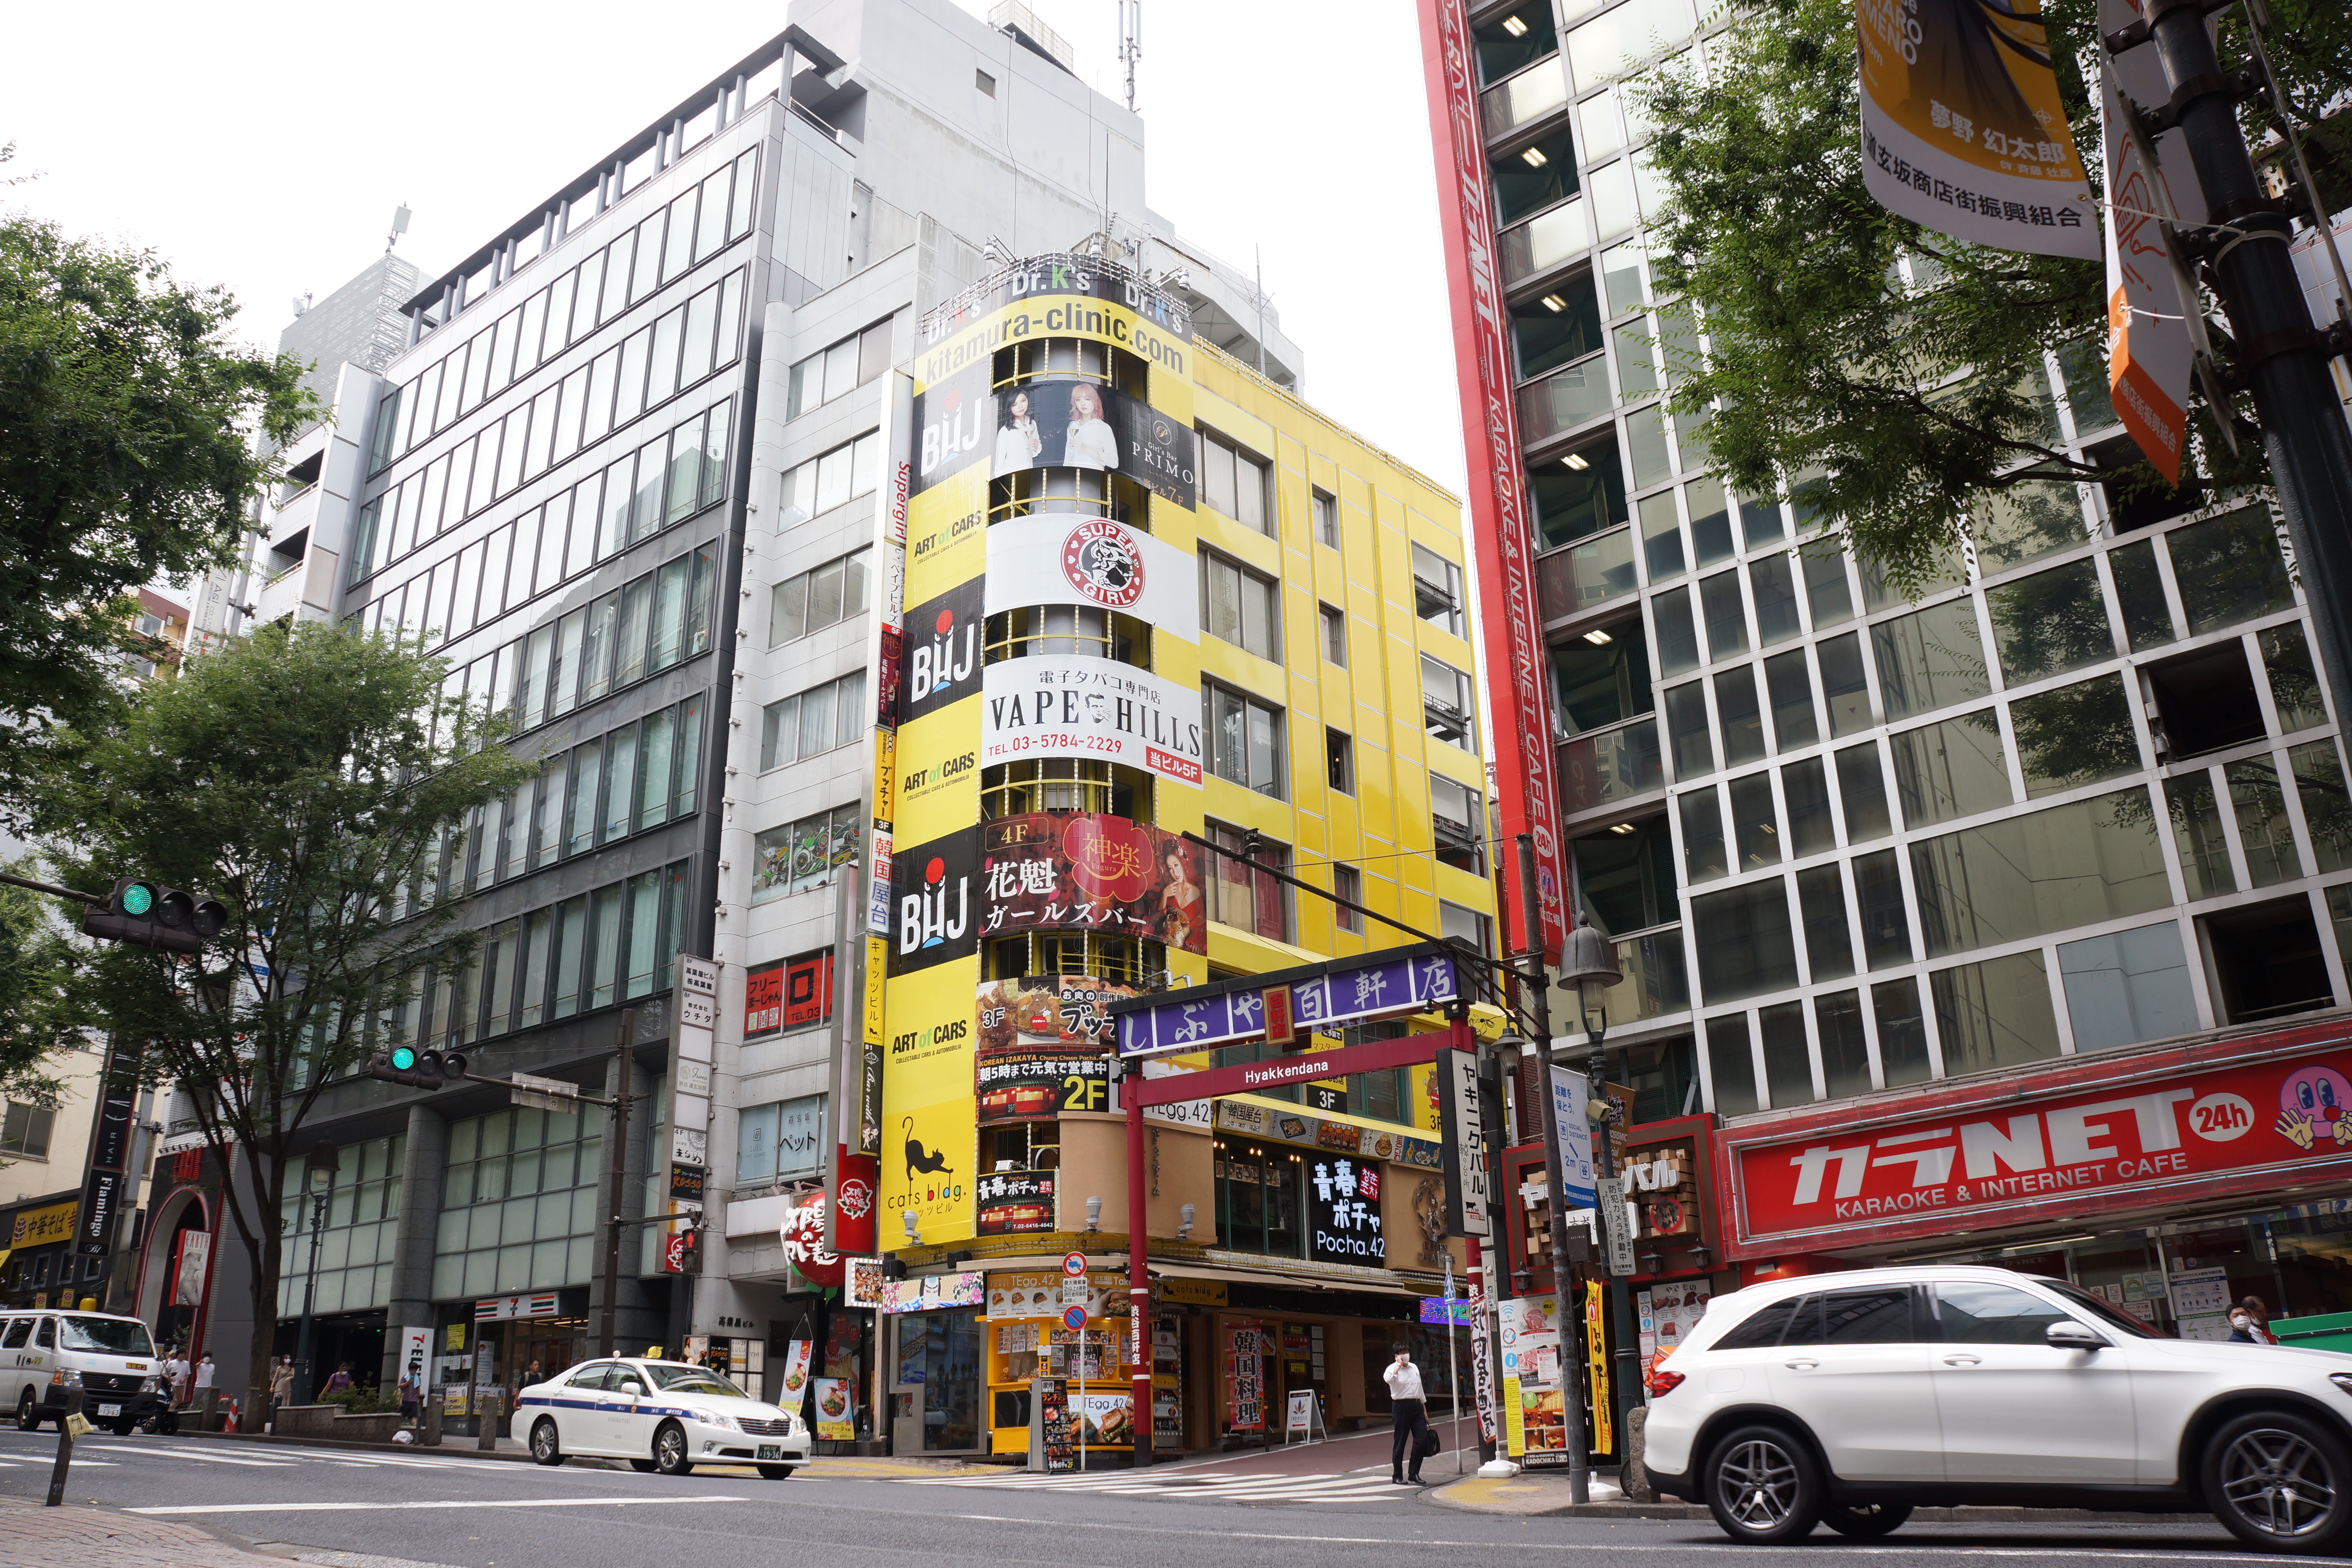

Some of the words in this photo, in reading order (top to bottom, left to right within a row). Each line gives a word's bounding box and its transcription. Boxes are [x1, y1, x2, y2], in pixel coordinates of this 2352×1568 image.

[1931, 99, 1975, 143] 夢野
[1983, 127, 2066, 164] 幻太郎
[1012, 265, 1091, 297] Dr.K's
[1125, 282, 1183, 334] Dr.K's
[926, 303, 1184, 385] kitamura-clinic.com
[1132, 441, 1194, 485] PRIMO
[1147, 440, 1165, 458] Girl's
[1166, 451, 1178, 462] Bar
[1490, 394, 1516, 539] KARAOKE
[892, 460, 911, 540] Supergirl
[914, 533, 937, 558] ART
[938, 526, 950, 546] of
[951, 510, 982, 538] CARS
[1078, 524, 1136, 557] SUPER
[1506, 540, 1519, 559] &
[1083, 582, 1131, 605] GIRL
[891, 627, 901, 635] 5F
[1509, 567, 1536, 723] INTERNET
[879, 659, 888, 710] 花魁ガールズバー
[1039, 670, 1161, 705] 電子タバコ専門店
[990, 690, 1079, 731] VAPE
[1114, 696, 1201, 757] HILLS
[988, 734, 1122, 757] TEL.03-5784-2229
[904, 769, 928, 794] ART
[928, 764, 941, 784] of
[943, 751, 975, 778] CARS
[1150, 751, 1198, 779] 当ビル5F
[1527, 737, 1546, 821] CAFE
[879, 765, 893, 817] ブッチャー
[907, 788, 931, 802] COLLECTABLE
[931, 783, 941, 792] CARS
[945, 774, 969, 787] AUTOMOBILIA
[878, 820, 890, 830] 3F
[1001, 824, 1029, 844] 4F
[1082, 833, 1141, 878] 神楽
[1535, 831, 1552, 852] 24h
[984, 857, 1058, 901] 花魁
[1091, 862, 1117, 873] kagura
[870, 837, 893, 927] 韓国屋台
[983, 901, 1147, 933] ガールズバー
[686, 967, 715, 980] 高葉屋ビル
[749, 978, 779, 995] フリー
[868, 941, 880, 1022] キャッツビル
[688, 1002, 708, 1012] 株式会社
[748, 990, 782, 1009] まーじゃん
[1061, 989, 1096, 1002] お肉の
[684, 1009, 712, 1023] ウチダ
[982, 1007, 1005, 1029] 3F
[1269, 993, 1286, 1039] 百軒店
[892, 1032, 918, 1054] ART
[918, 1028, 932, 1049] of
[933, 1019, 967, 1045] CARS
[896, 1053, 921, 1065] COLLECTABLE
[921, 1051, 931, 1059] CARS
[936, 1043, 962, 1055] AUTOMOBILIA
[980, 1058, 1004, 1067] KOREAN
[1006, 1054, 1037, 1063] IZAKAYA
[980, 1061, 1107, 1082] 朝5時まで元気で営業中
[1245, 1061, 1328, 1085] Hyakkendana
[1063, 1075, 1106, 1110] 2F
[1319, 1091, 1336, 1109] 3F
[1555, 1084, 1572, 1099] 距離を
[788, 1112, 811, 1125] 道玄坂
[1228, 1102, 1261, 1124] 韓国屋台
[1556, 1099, 1575, 1114] 保とう。
[2195, 1103, 2248, 1136] 24h
[1463, 1063, 1484, 1195] ヤキニクバル
[1560, 1126, 1567, 1137] 渋
[1568, 1123, 1582, 1132] SOCIAL
[1569, 1131, 1588, 1141] DISTANCE
[105, 1131, 117, 1163] HAIR
[1789, 1087, 2194, 1206] カラNET
[681, 1170, 702, 1179] フリーまーじゃん
[1565, 1155, 1576, 1169] 2m
[1581, 1164, 1588, 1176] 谷
[671, 1176, 702, 1189] ROSSO
[978, 1176, 1038, 1201] 青春ポチャ
[1313, 1158, 1357, 1202] 青春
[1835, 1184, 1946, 1220] KARAOKE
[1956, 1184, 1971, 1202] &
[1980, 1163, 2106, 1206] INTERNET
[2117, 1151, 2189, 1180] CAFE
[90, 1176, 113, 1237] Flamingo
[887, 1190, 920, 1209] cats
[927, 1181, 967, 1203] bldg.
[28, 1209, 69, 1241] 中華そば
[1333, 1199, 1380, 1233] ポチャ
[1608, 1185, 1627, 1261] 防犯カメラ作動中
[1616, 1181, 1632, 1253] みなさまの安全を守ります
[185, 1232, 210, 1250] EARTH
[1317, 1230, 1385, 1258] Pocha.42
[855, 1263, 880, 1272] Pocha.42
[1011, 1273, 1055, 1287] TEgg.42
[1176, 1282, 1192, 1294] cats
[1131, 1305, 1140, 1365] 渋谷百軒店
[1233, 1330, 1261, 1425] 韓国料理
[763, 1450, 780, 1459] 19-36
